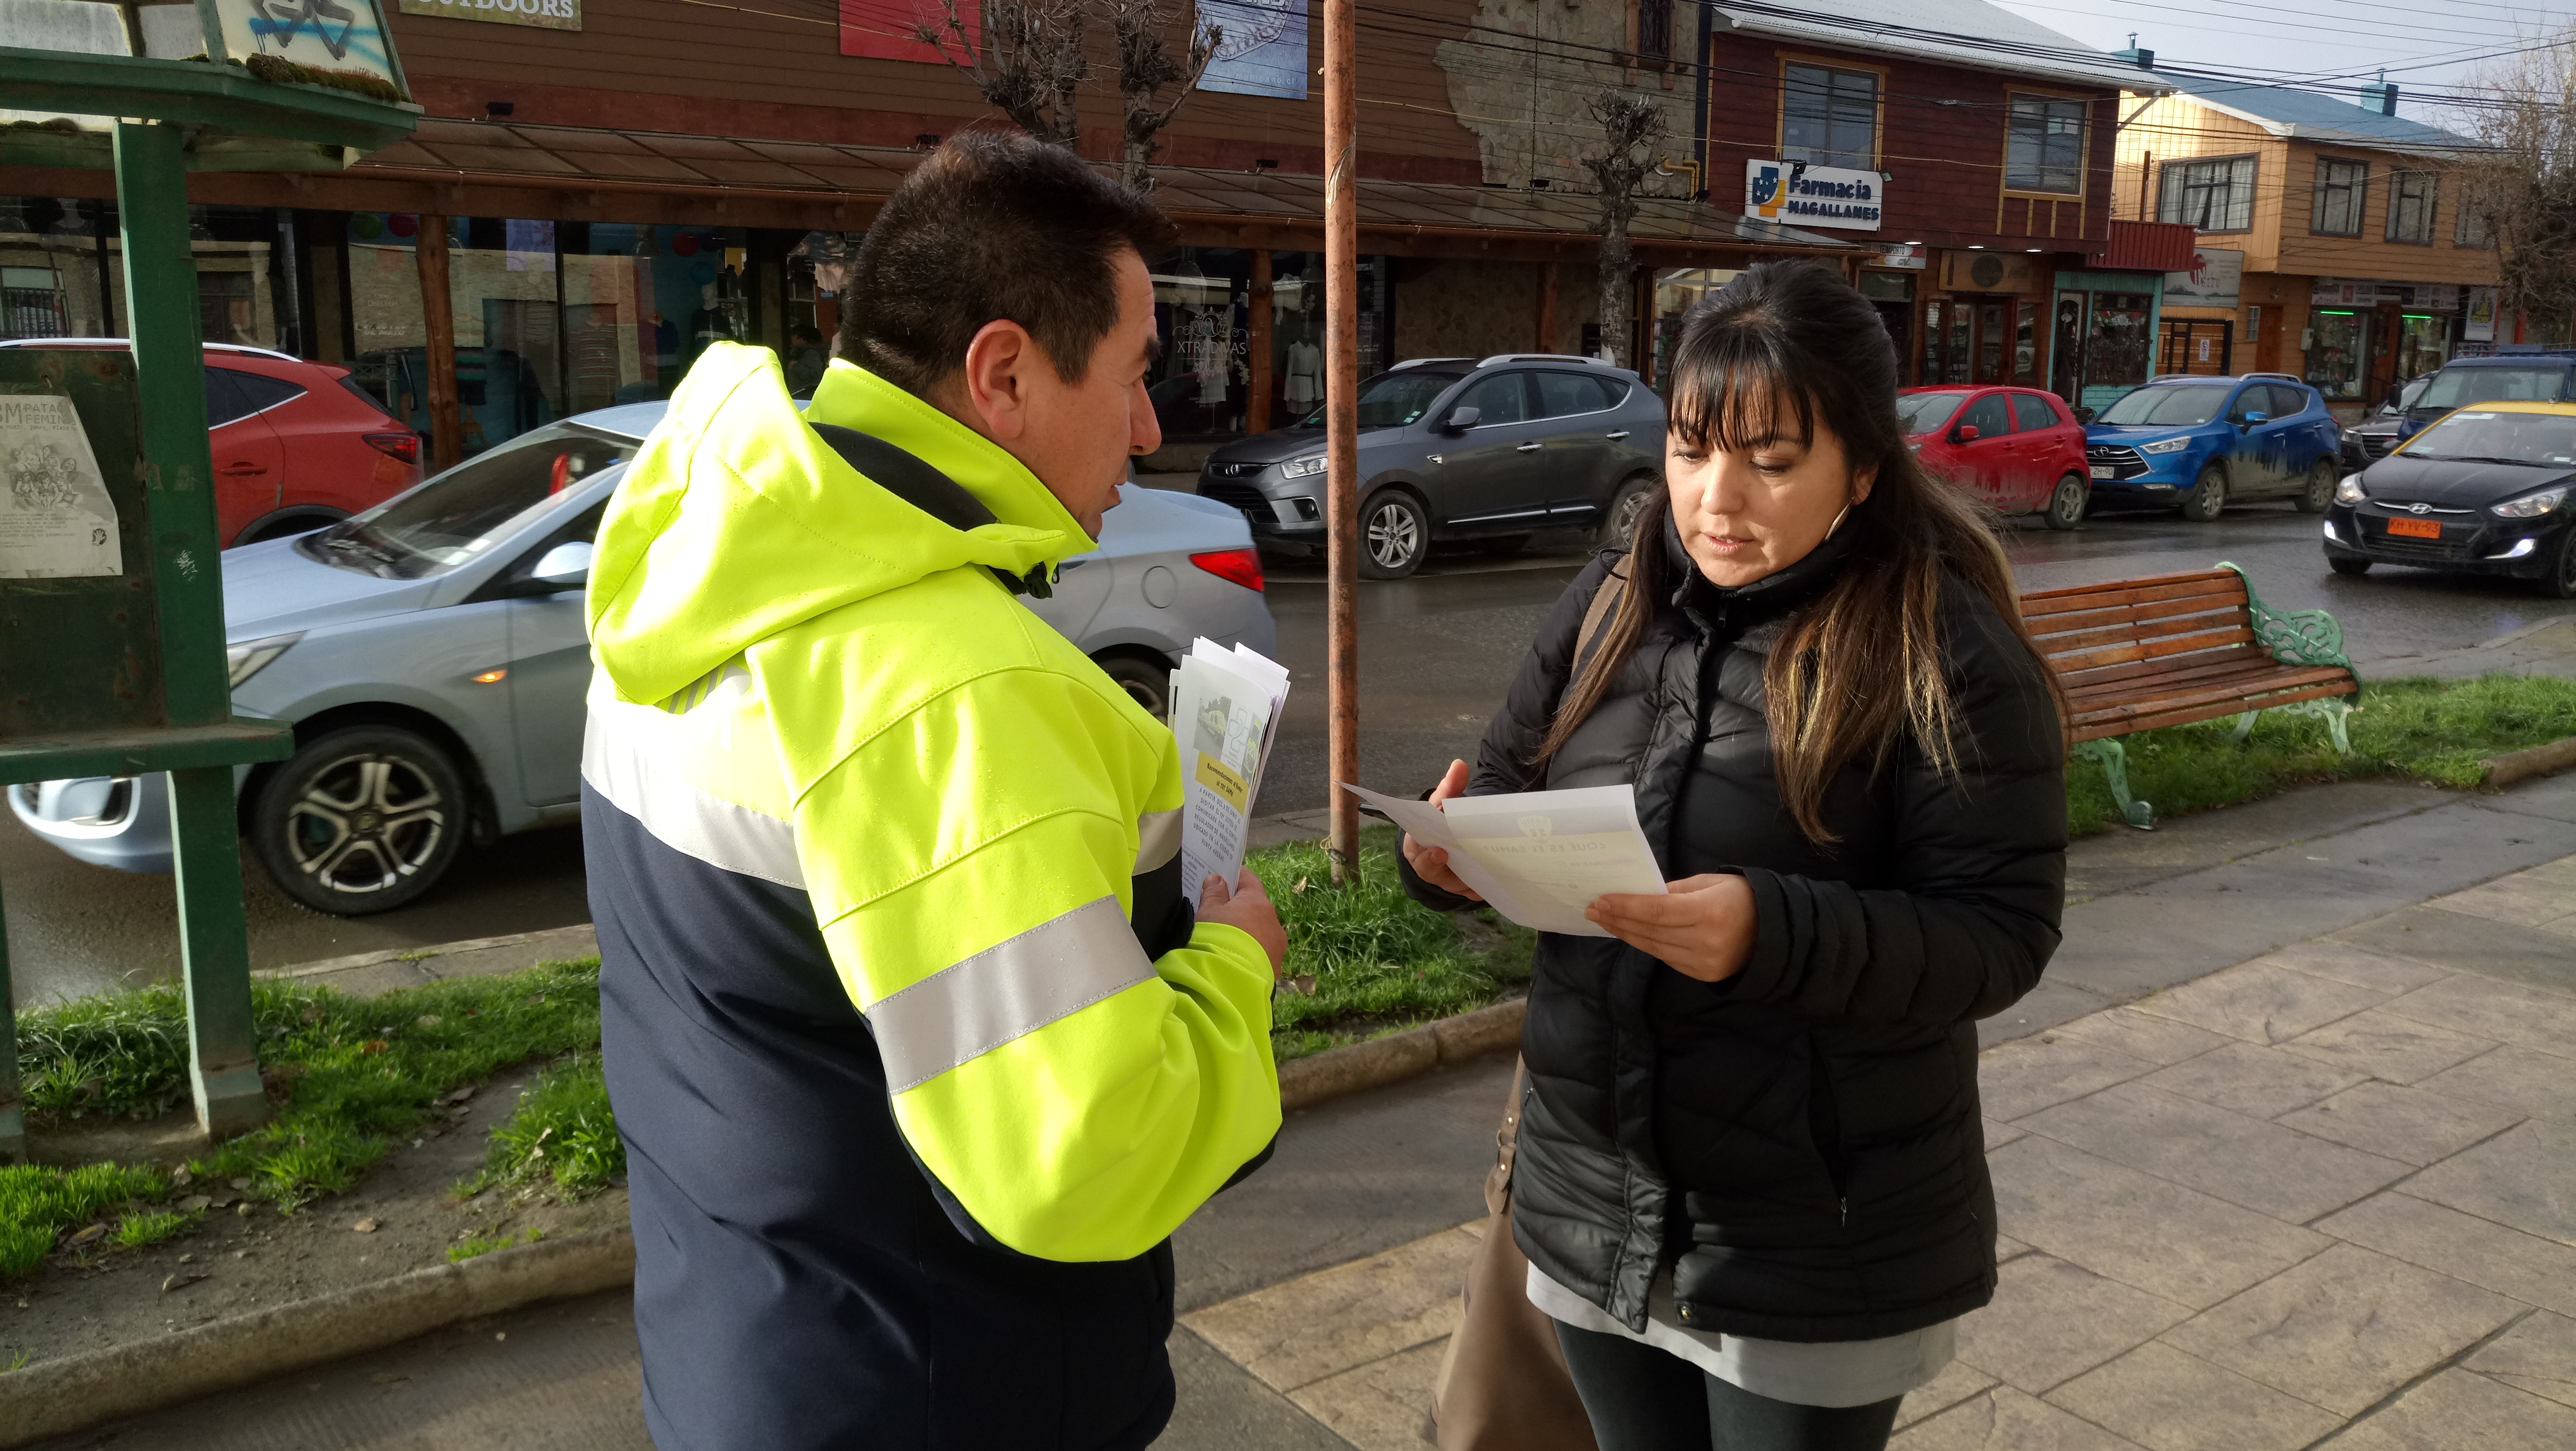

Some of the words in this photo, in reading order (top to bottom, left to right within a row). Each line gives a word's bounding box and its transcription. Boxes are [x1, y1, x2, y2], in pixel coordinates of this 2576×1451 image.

[1789, 174, 1871, 199] Farmacia
[1788, 200, 1879, 220] MAGALLANES
[1176, 341, 1246, 355] XTRADIVAS
[1200, 797, 1215, 811] DIGITAR
[1203, 789, 1216, 802] PARTIR
[1194, 813, 1214, 831] REGULADOR
[1193, 822, 1208, 837] UBICADO
[1219, 843, 1229, 856] CIUDAD
[1201, 838, 1212, 851] PUNTA
[1212, 848, 1224, 862] ARENAS
